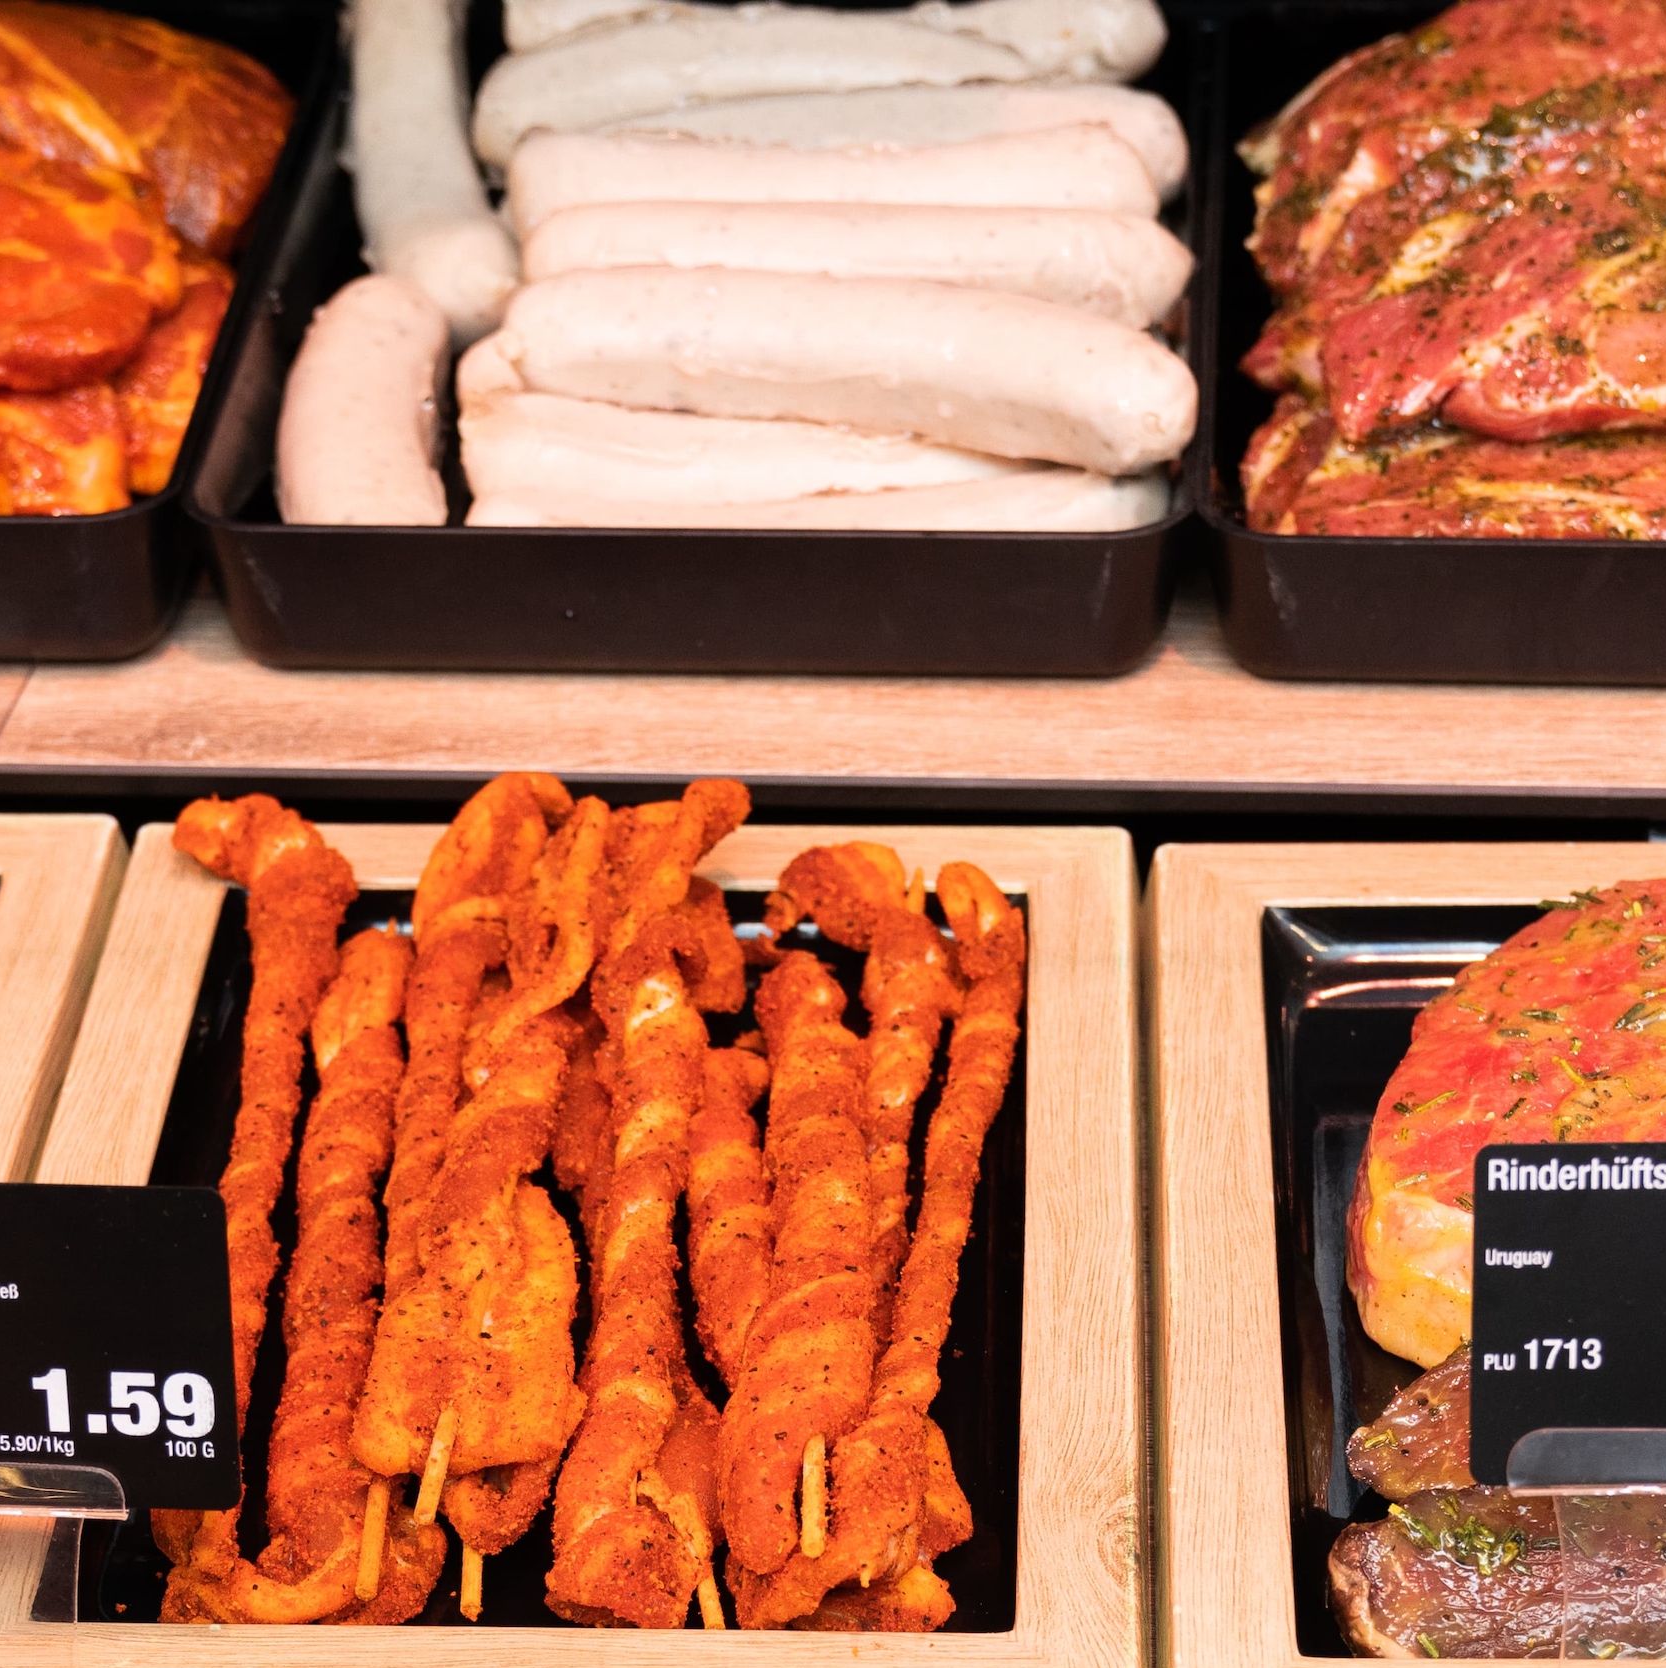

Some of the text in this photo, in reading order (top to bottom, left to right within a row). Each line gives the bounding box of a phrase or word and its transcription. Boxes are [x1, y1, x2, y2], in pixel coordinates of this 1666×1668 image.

[1485, 1248, 1552, 1268] Uruguay
[1484, 1338, 1602, 1371] PLU 1713
[31, 1368, 215, 1438] 1.59
[165, 1440, 198, 1458] 100
[202, 1441, 214, 1458] G
